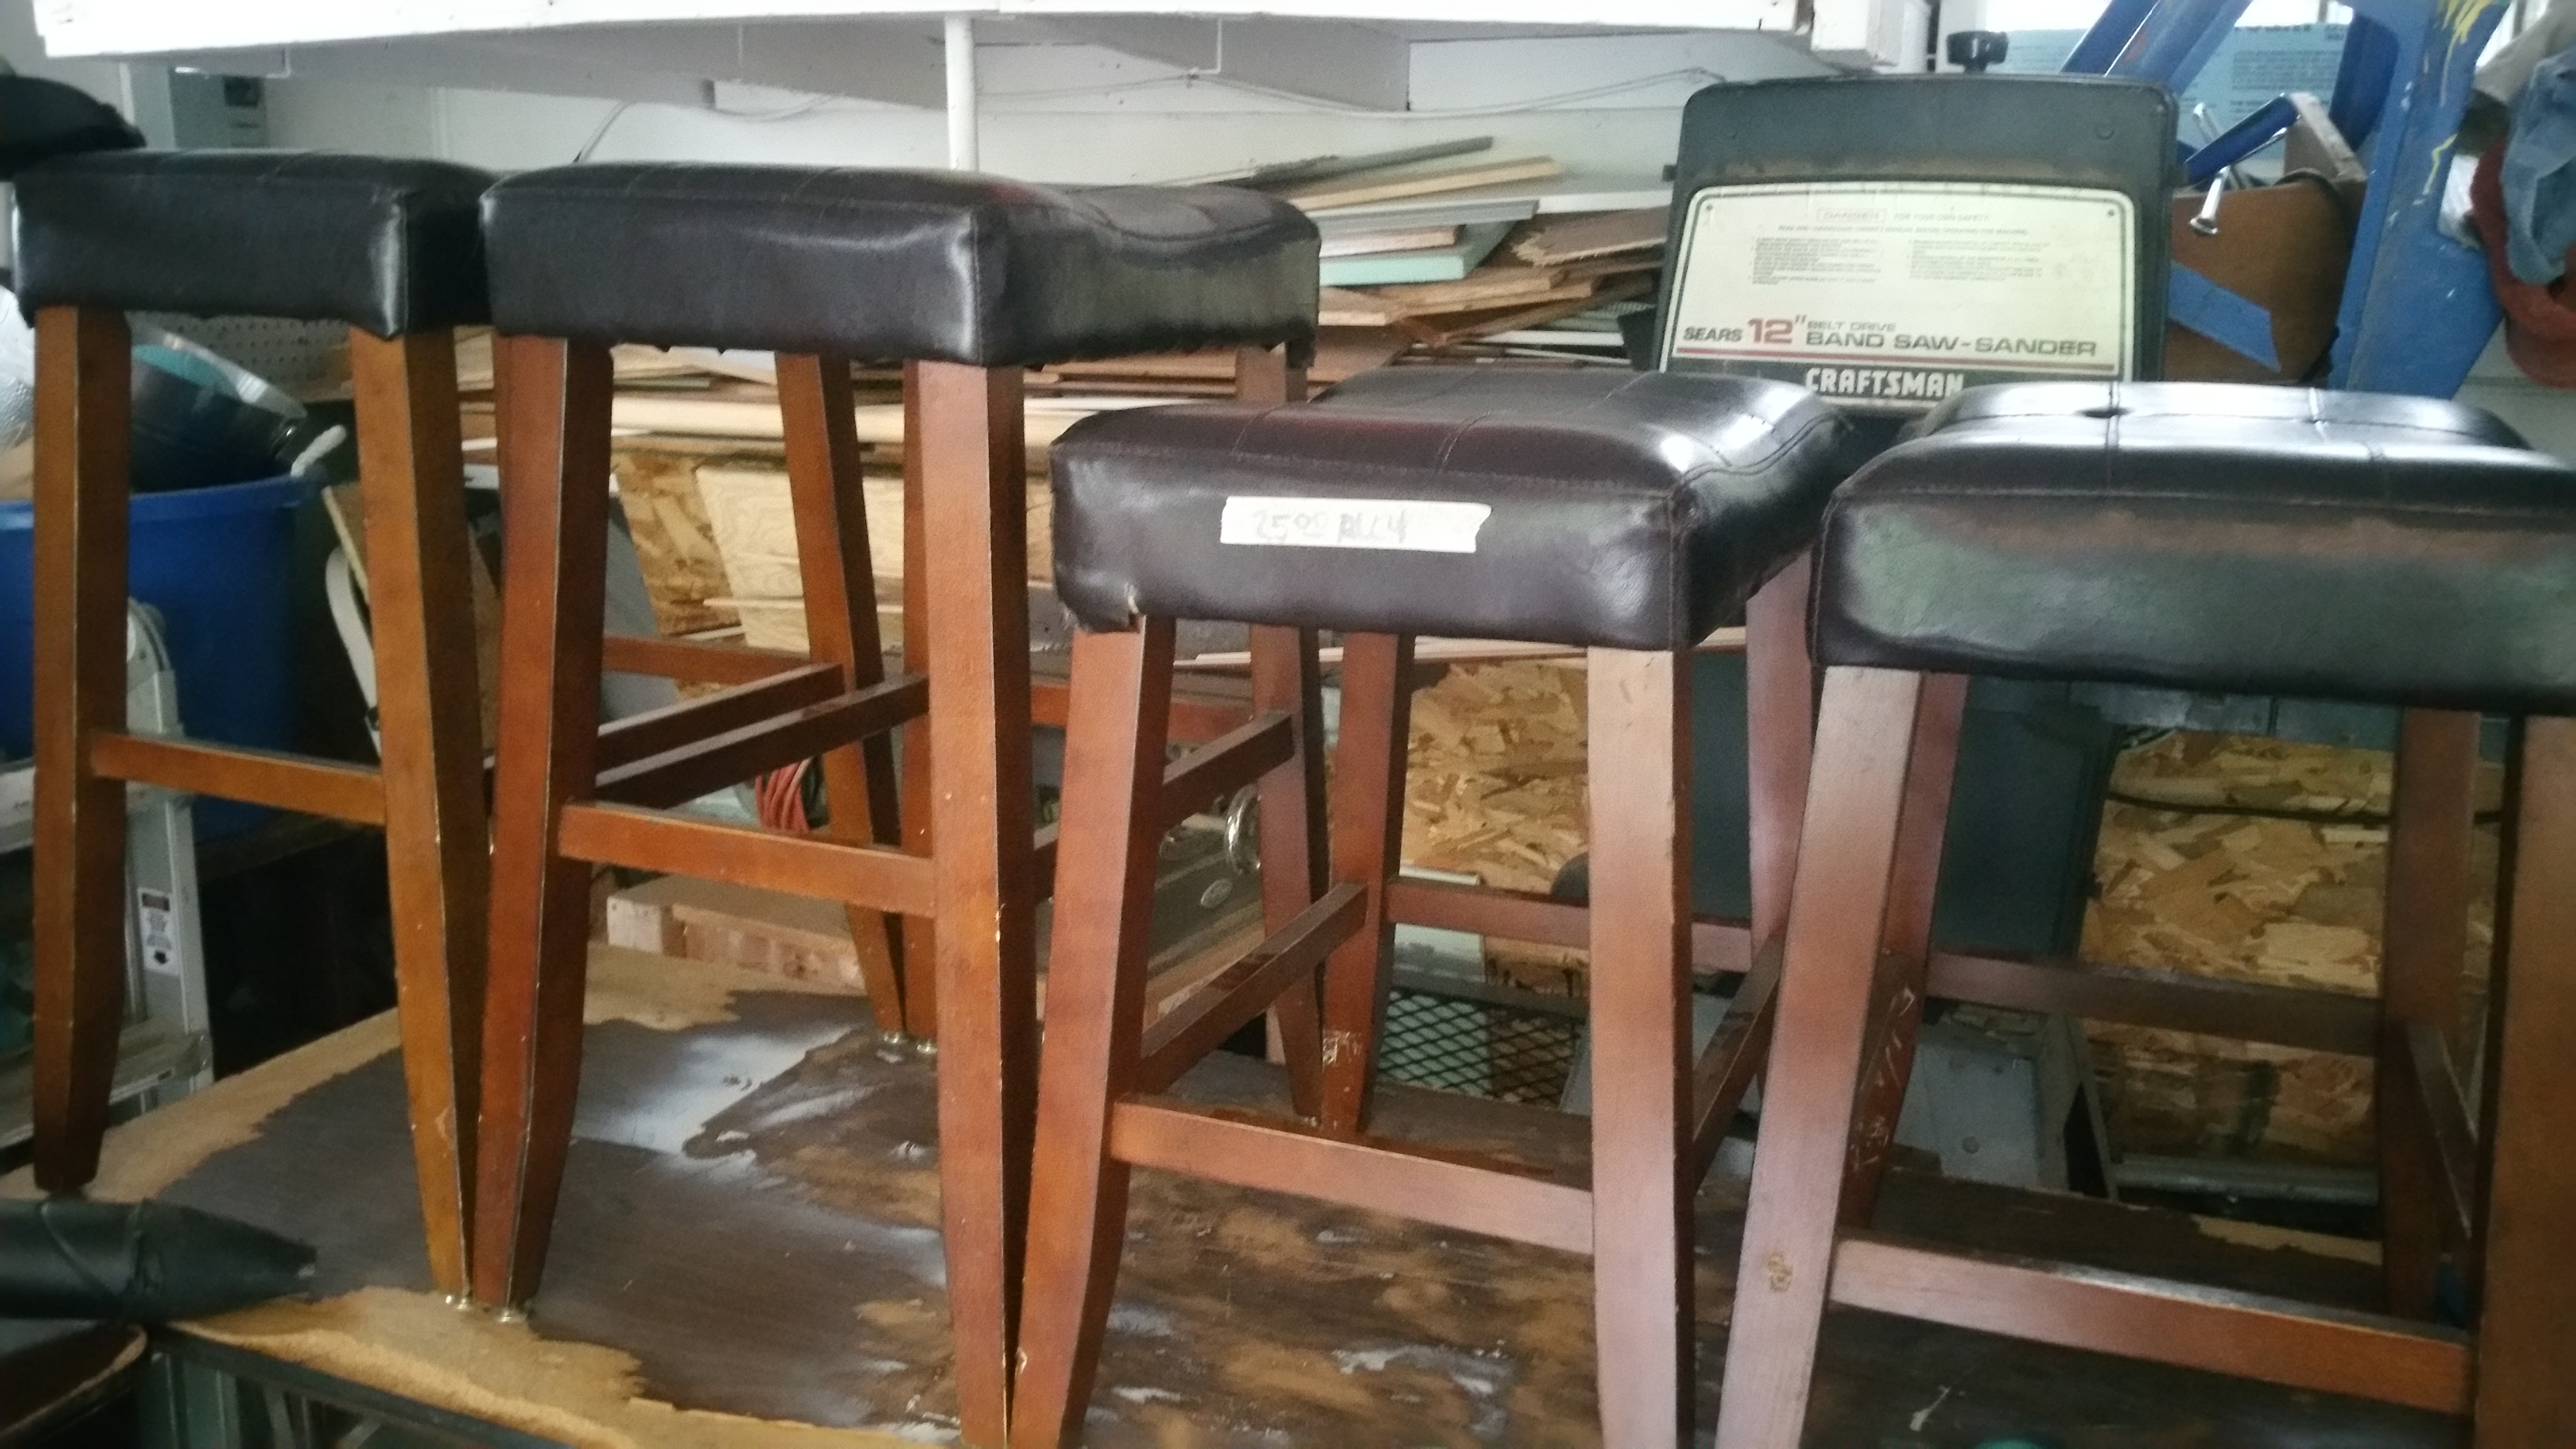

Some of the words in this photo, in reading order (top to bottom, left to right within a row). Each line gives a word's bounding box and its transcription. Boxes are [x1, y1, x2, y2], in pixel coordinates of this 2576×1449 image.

[1683, 326, 1742, 341] SEARS
[1748, 315, 1806, 344] 12"
[1807, 320, 1846, 330] BELT
[1849, 322, 1897, 332] DRIVE
[1806, 331, 1886, 348] BAND
[1805, 368, 1964, 397] CRAFTSMAN
